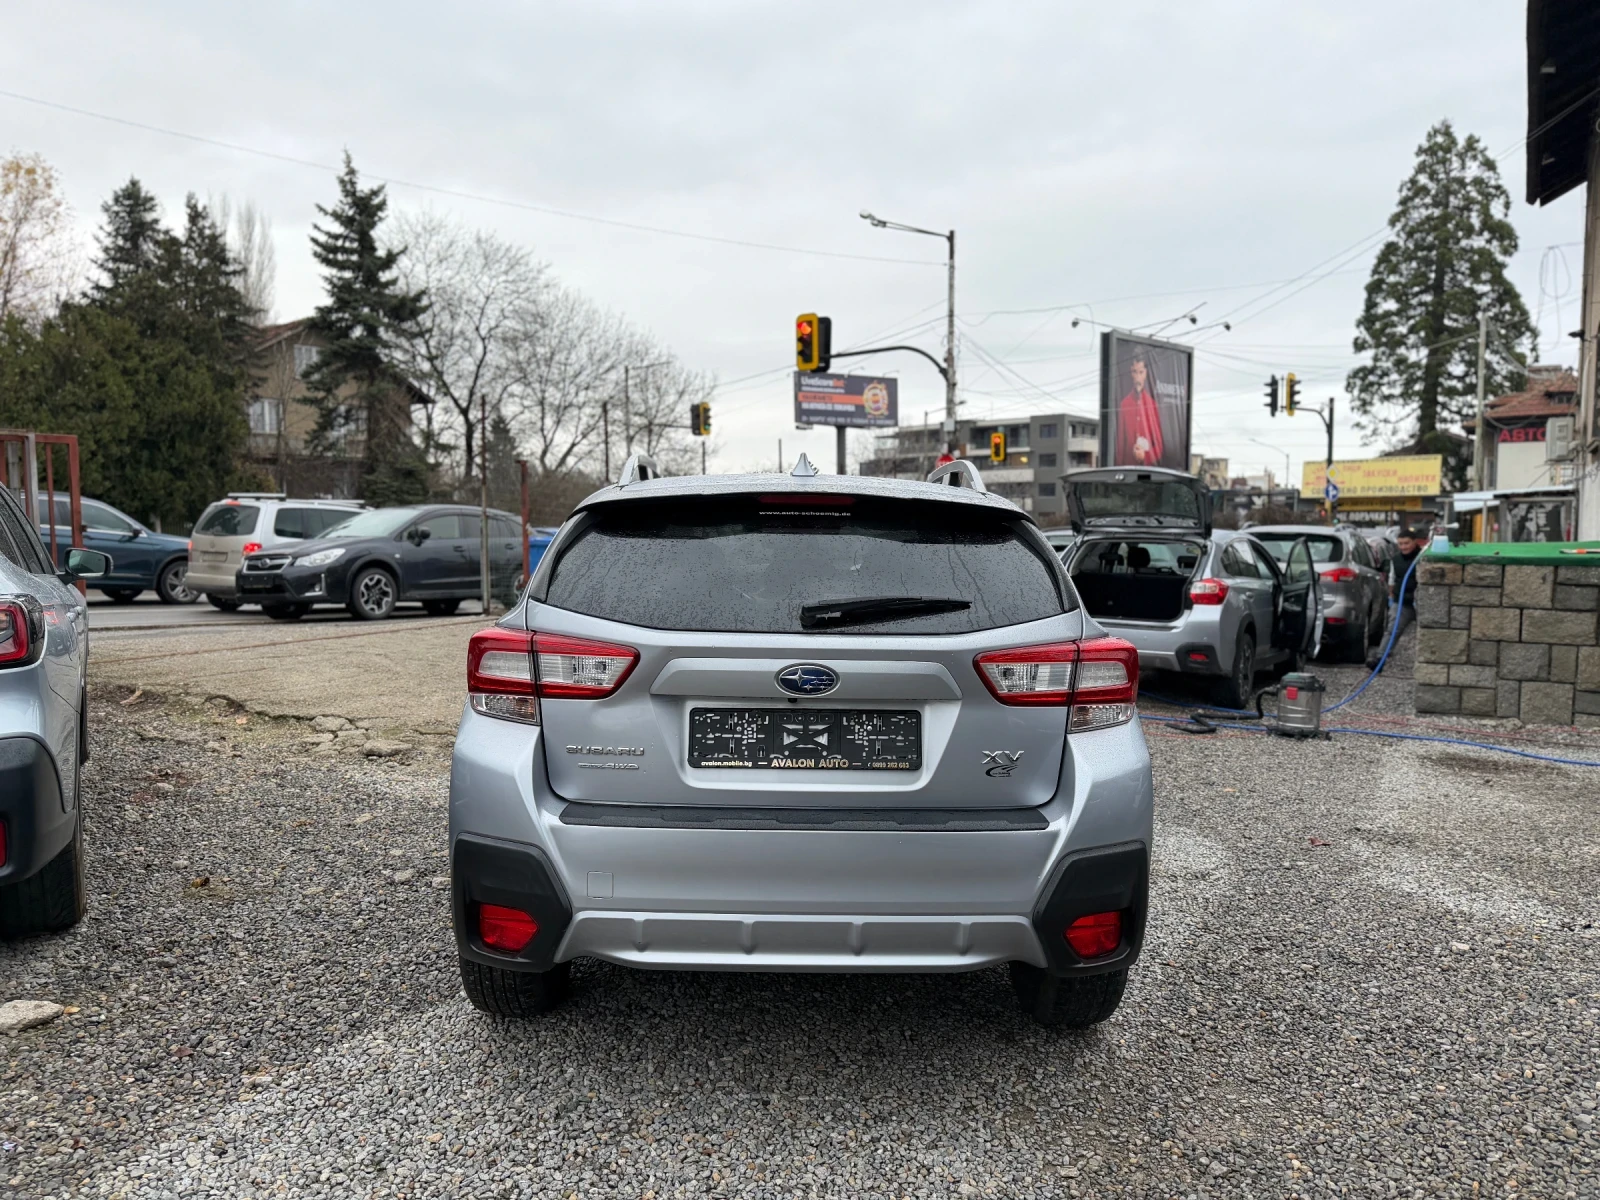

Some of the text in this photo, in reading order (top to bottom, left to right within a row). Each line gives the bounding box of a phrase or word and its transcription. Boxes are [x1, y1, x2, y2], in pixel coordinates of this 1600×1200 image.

[565, 745, 645, 757] SUBARU
[981, 750, 1025, 764] XV
[700, 760, 753, 768] avalon.mobile.bg
[771, 759, 815, 768] AVALON
[818, 759, 849, 768] AUTO
